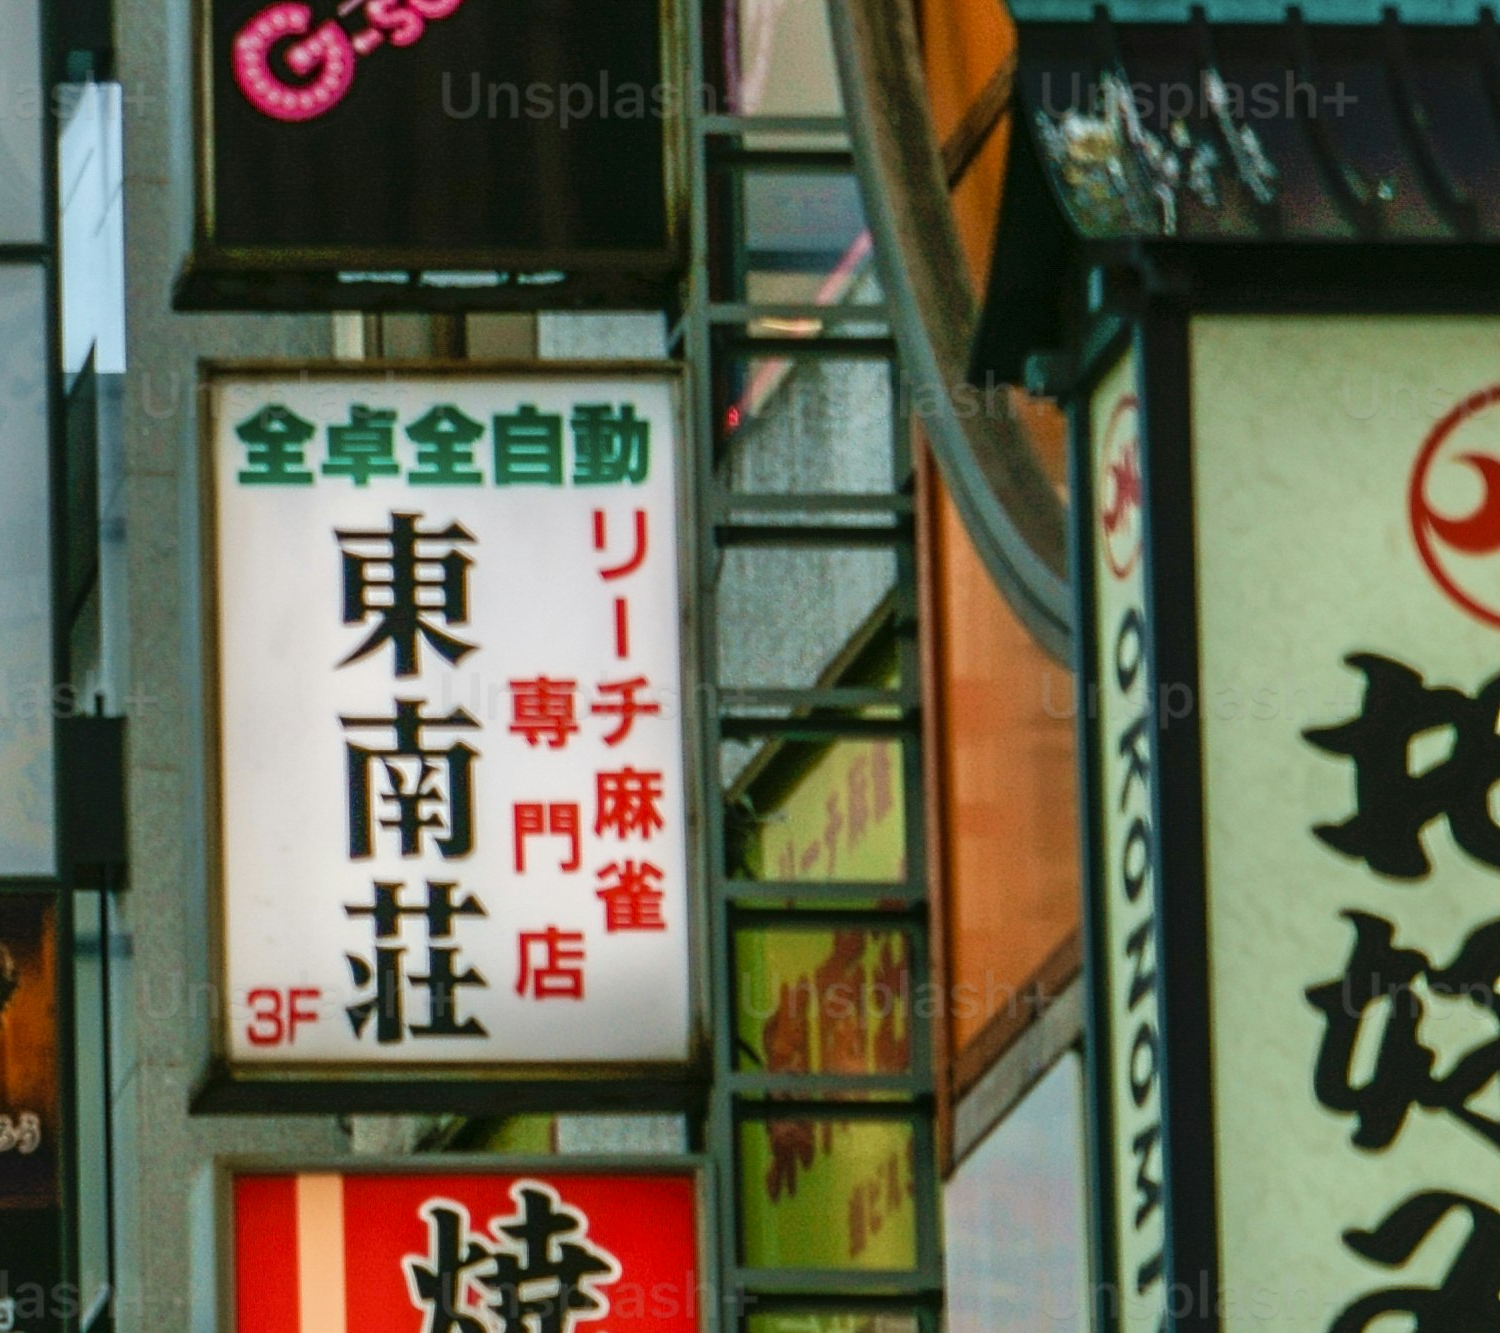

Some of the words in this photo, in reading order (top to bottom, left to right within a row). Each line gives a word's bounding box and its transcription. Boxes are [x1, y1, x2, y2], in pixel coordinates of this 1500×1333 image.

[234, 405, 652, 489] 全卓全自動
[334, 511, 490, 1048] 東南荘
[508, 679, 586, 1003] 専門店
[589, 508, 668, 936] リーチ麻雀
[246, 988, 323, 1048] 3F
